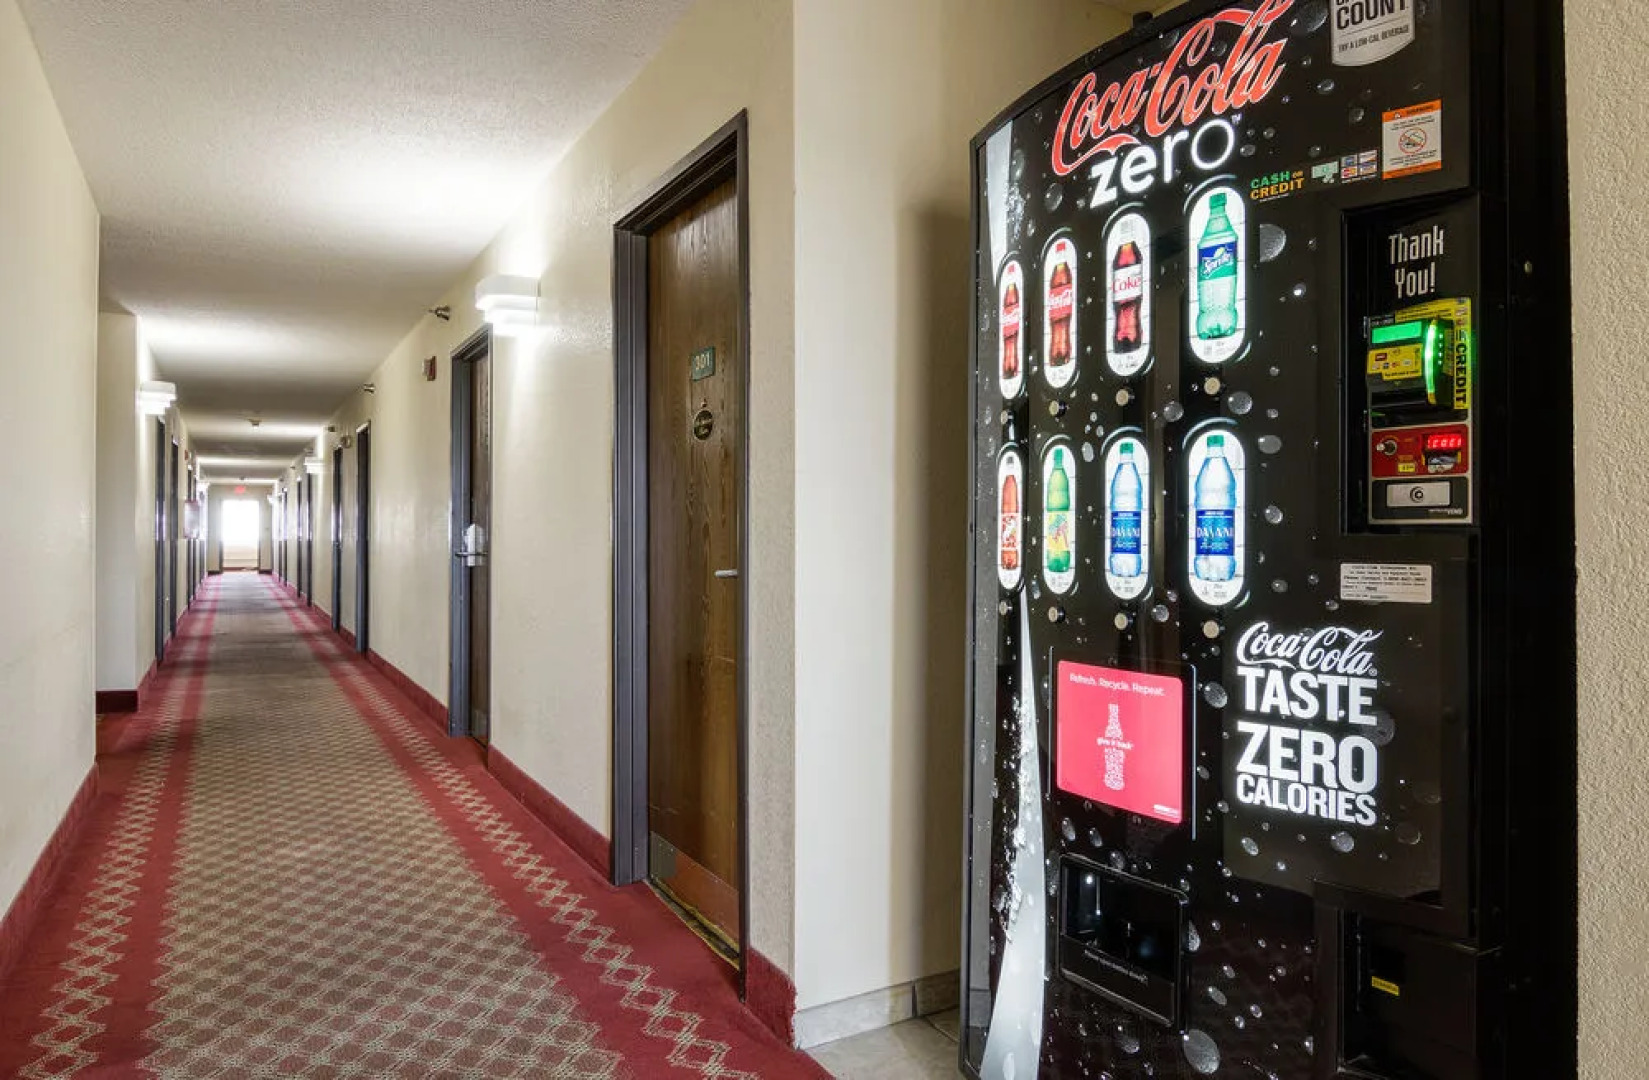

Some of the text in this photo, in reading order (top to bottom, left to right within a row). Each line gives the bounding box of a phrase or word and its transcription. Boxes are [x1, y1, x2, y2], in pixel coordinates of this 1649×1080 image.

[1051, 0, 1296, 176] Coca-Cola
[1090, 119, 1235, 209] zero
[1249, 177, 1305, 200] CREDIT
[1250, 171, 1291, 189] CASH
[1388, 225, 1444, 264] Thank
[1112, 276, 1142, 294] Coke
[1394, 262, 1435, 299] You!
[1456, 342, 1467, 404] CREDIT
[1236, 621, 1384, 676] Coca-Cola
[1237, 666, 1378, 726] TASTE
[1236, 721, 1378, 793] ZERO
[1236, 773, 1377, 827] CALORIES
